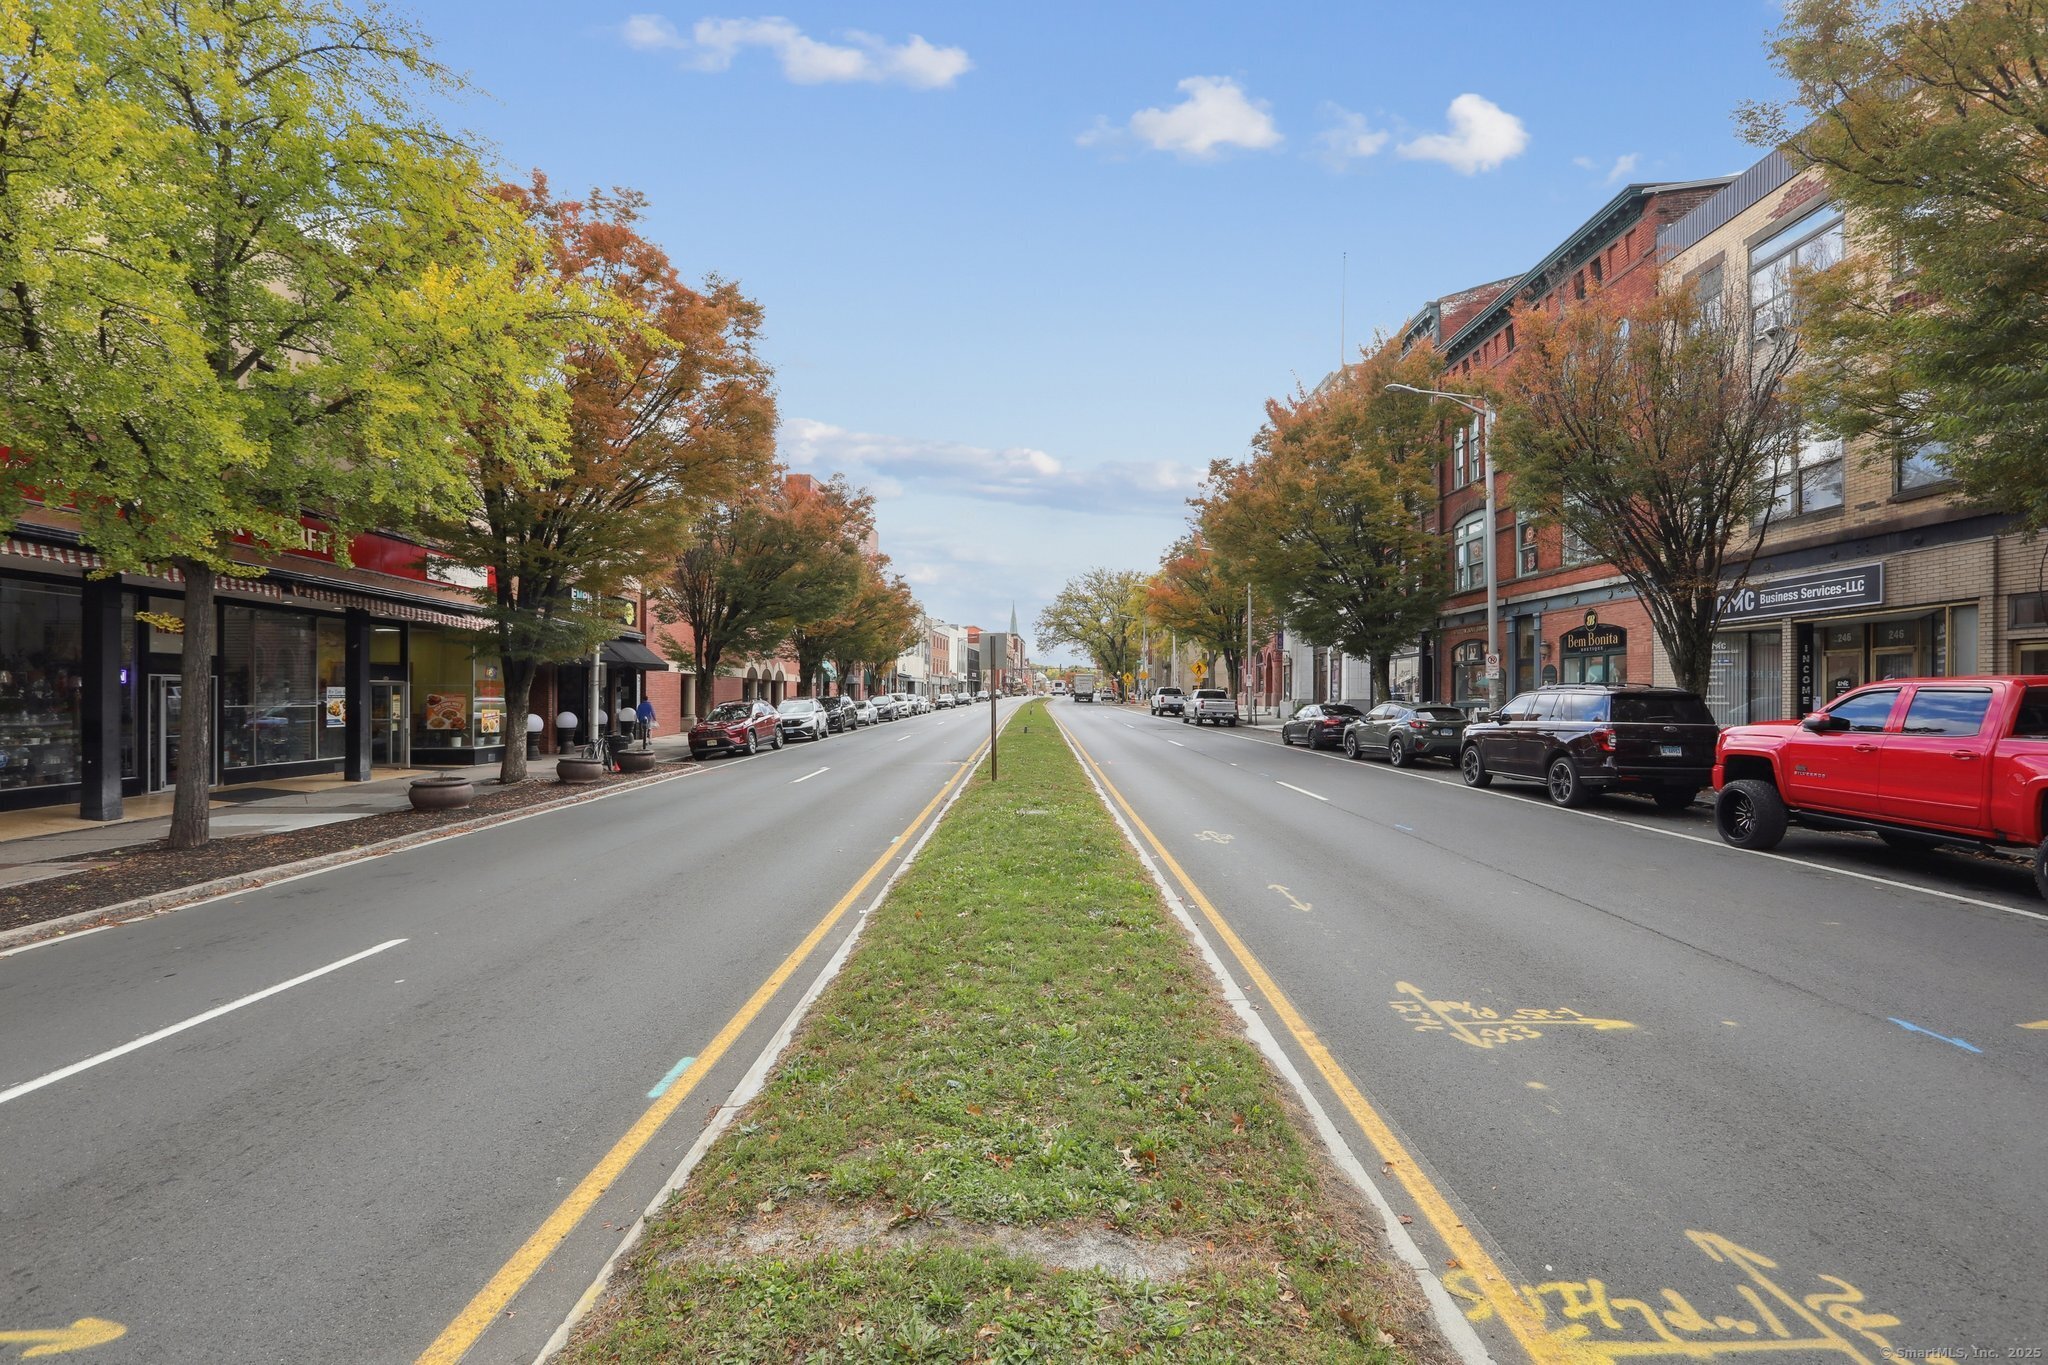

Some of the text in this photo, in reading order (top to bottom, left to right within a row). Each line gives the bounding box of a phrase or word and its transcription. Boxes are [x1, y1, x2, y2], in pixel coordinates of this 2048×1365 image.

[1759, 591, 1799, 605] Business
[1800, 579, 1865, 599] Services-LLC
[1568, 632, 1619, 648] Bem Bonita
[1837, 632, 1852, 643] 246
[1888, 629, 1905, 640] 246
[1802, 644, 1811, 705] INCOME
